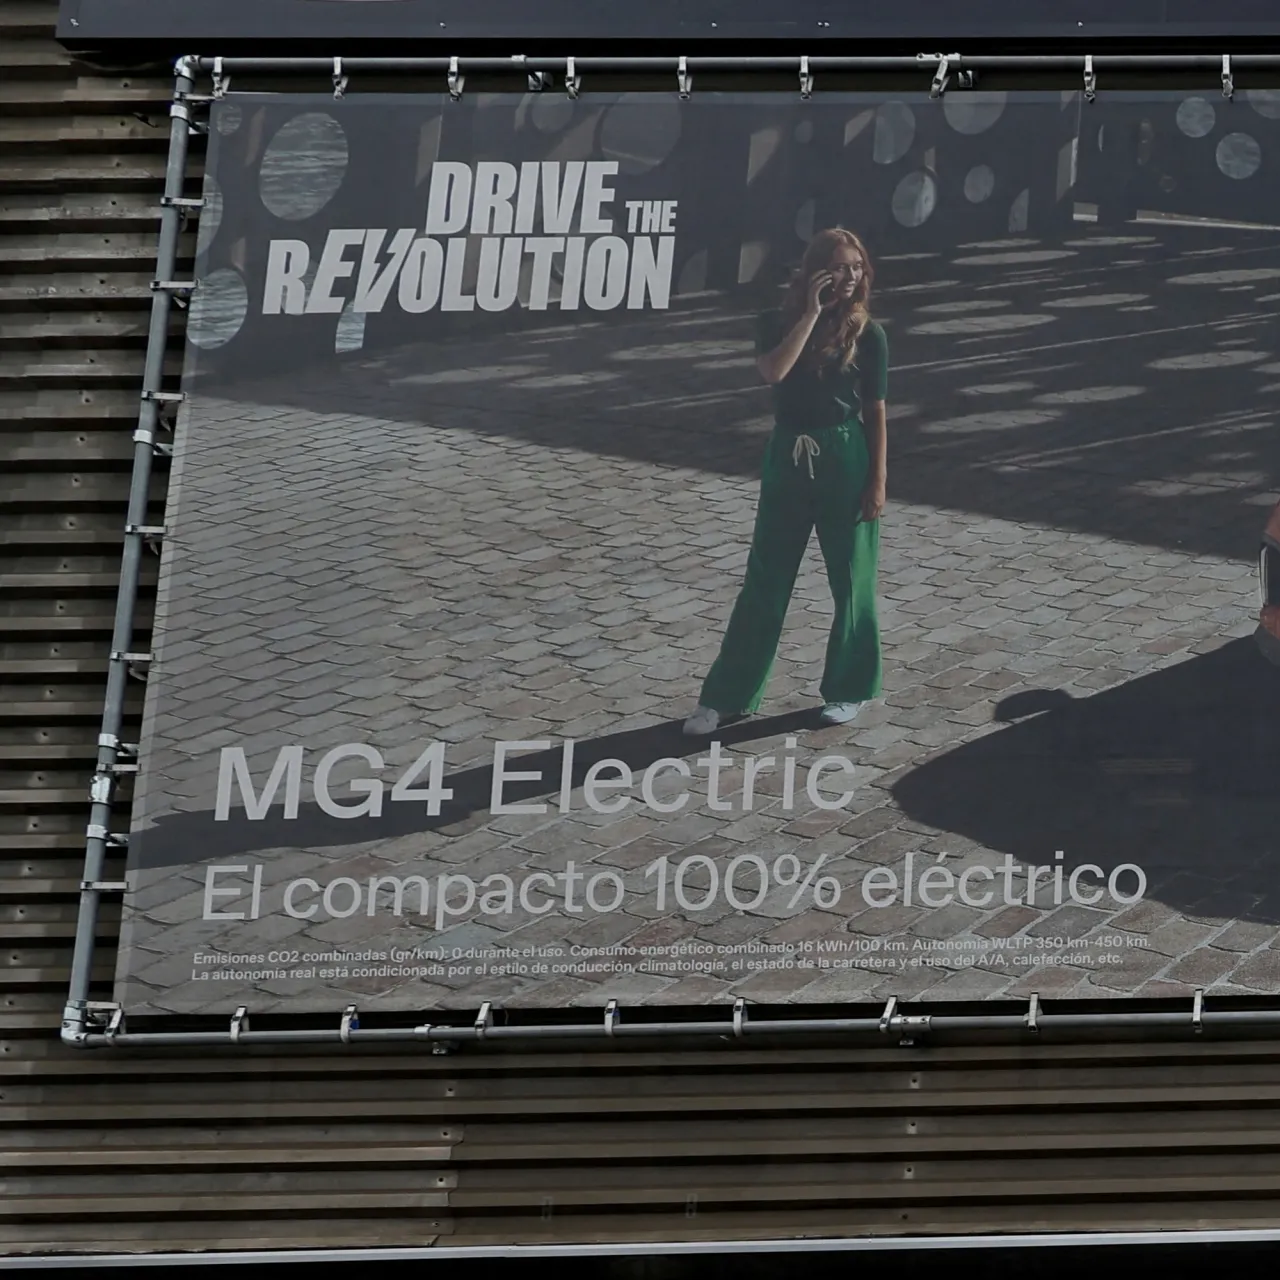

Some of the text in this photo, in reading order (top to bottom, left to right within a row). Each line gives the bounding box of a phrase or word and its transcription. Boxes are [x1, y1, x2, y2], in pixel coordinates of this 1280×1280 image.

[425, 161, 678, 235] DRIVE THE
[262, 228, 675, 314] REVOLUTION
[214, 737, 855, 821] MG4 Electric
[202, 850, 1147, 931] El compacto 100% eléctrico
[191, 952, 1124, 980] La autonomía real está condicionada por el estilo de conducción, climatología, el estado de la carretera y el uso del A/A, calefacción, etc.
[193, 951, 264, 965] Emisiones
[268, 950, 299, 963] CO2
[302, 948, 387, 962] combinadas
[390, 946, 449, 964] (gr/km):
[466, 947, 518, 959] durante
[523, 945, 535, 958] el
[538, 946, 566, 957] uso.
[570, 945, 636, 957] Consumo
[640, 943, 713, 958] energético
[717, 941, 795, 954] combinado
[798, 941, 812, 952] 16
[816, 939, 881, 953] kWh/100
[883, 939, 908, 951] km.
[991, 937, 1033, 949] WLTP
[1036, 936, 1063, 948] 350
[1067, 936, 1122, 948] km-450
[1126, 935, 1151, 947] km.
